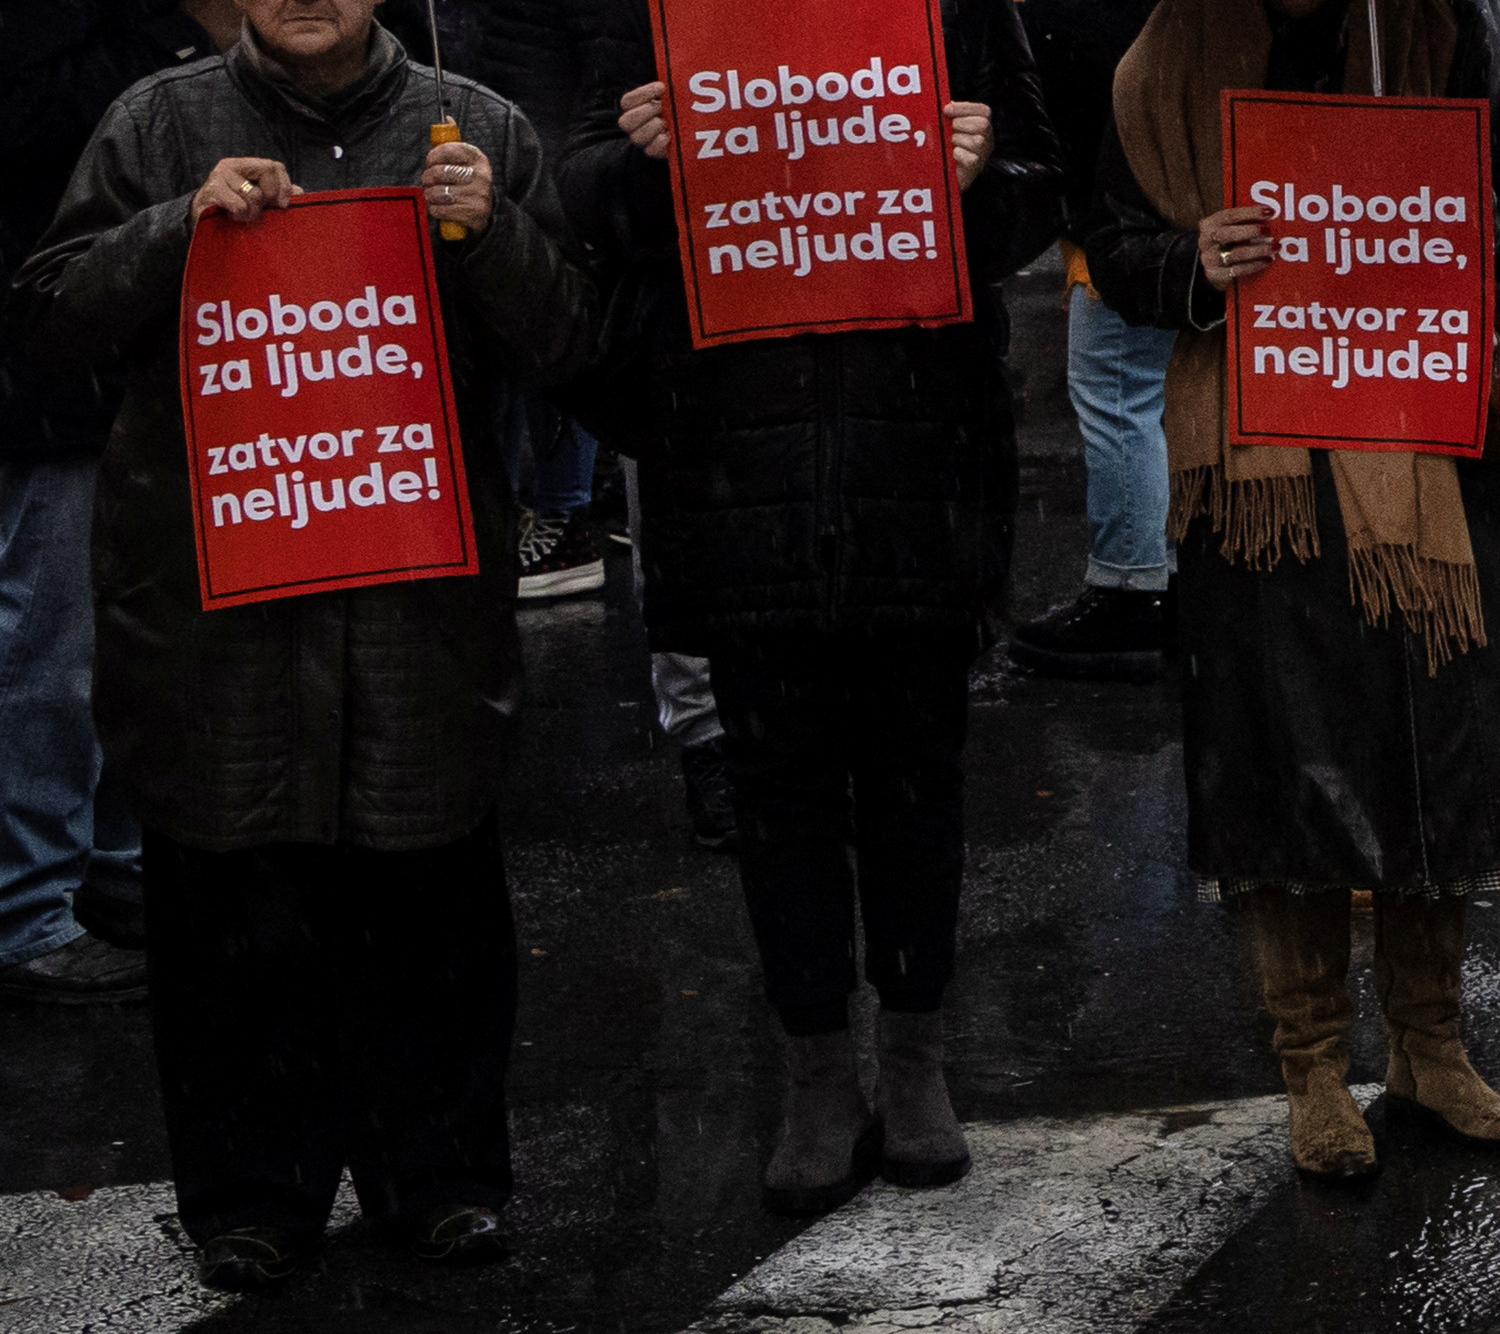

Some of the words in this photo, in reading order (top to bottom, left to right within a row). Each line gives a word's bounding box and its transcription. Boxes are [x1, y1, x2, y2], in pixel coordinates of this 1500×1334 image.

[688, 56, 922, 113] Sloboda
[695, 125, 759, 160] za
[774, 105, 926, 160] ljude,
[704, 191, 866, 229] zatvor
[876, 188, 933, 215] za
[1250, 180, 1466, 223] Sloboda
[708, 220, 938, 277] neljude!
[1266, 236, 1309, 263] a
[1324, 227, 1468, 275] ljude,
[196, 285, 417, 346] Sloboda
[1253, 301, 1407, 332] zatvor
[1416, 308, 1469, 335] za
[199, 359, 252, 396] za
[265, 335, 424, 398] ljude,
[1253, 336, 1468, 389] neljude!
[207, 428, 364, 475] zatvor
[376, 423, 434, 453] za
[211, 457, 441, 529] neljude!
